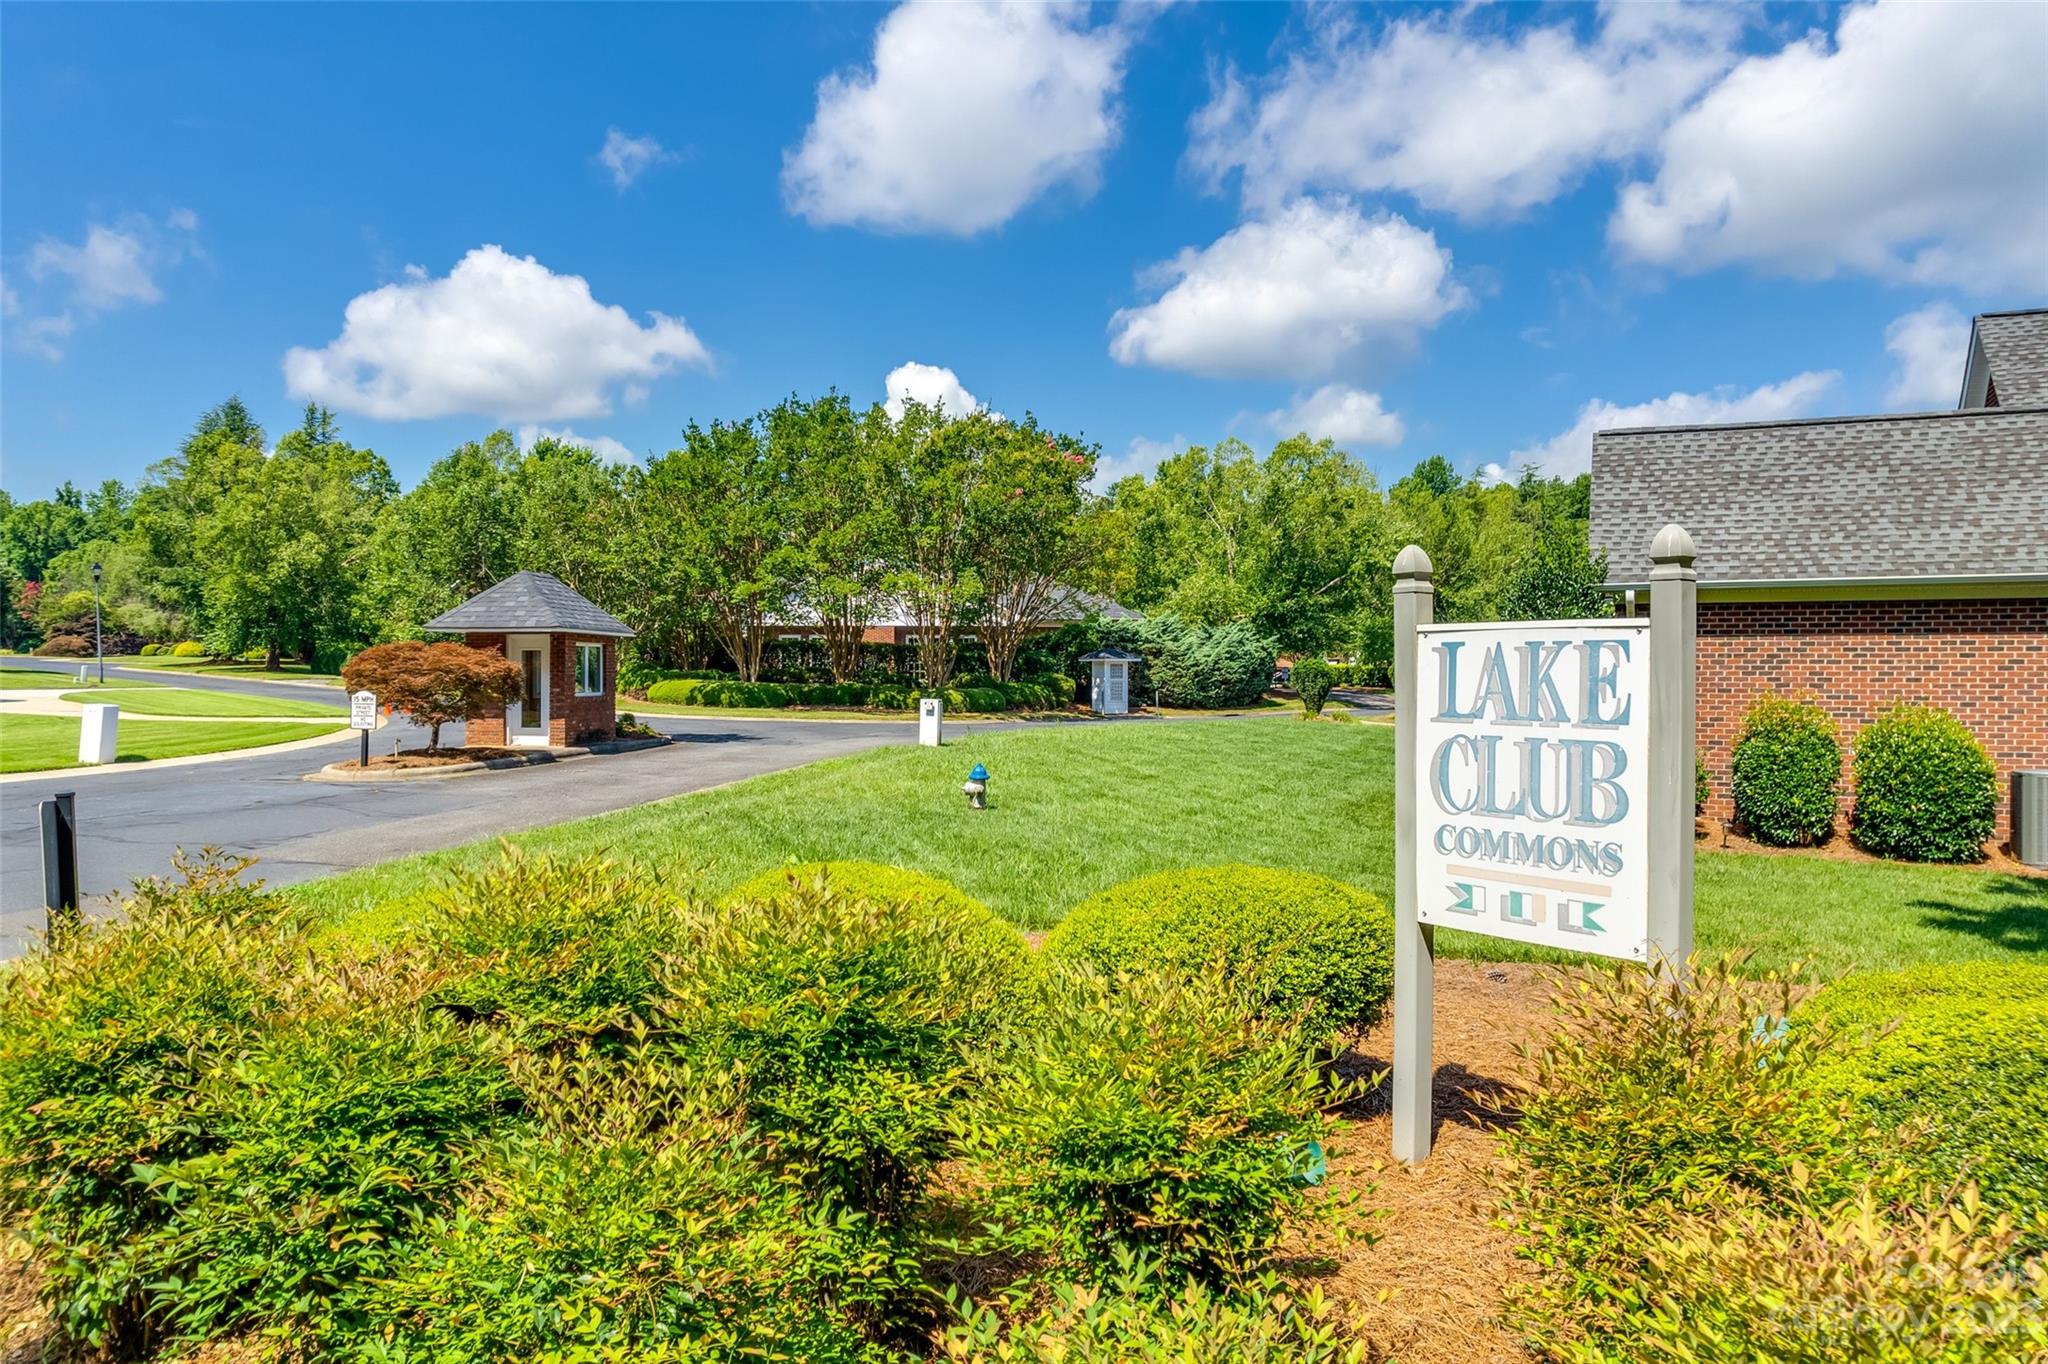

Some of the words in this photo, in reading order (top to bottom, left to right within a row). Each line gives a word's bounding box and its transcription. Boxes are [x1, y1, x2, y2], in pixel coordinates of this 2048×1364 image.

[1431, 639, 1631, 730] LAKE
[1430, 734, 1629, 829] CLUB
[1434, 824, 1624, 877] COMMONS
